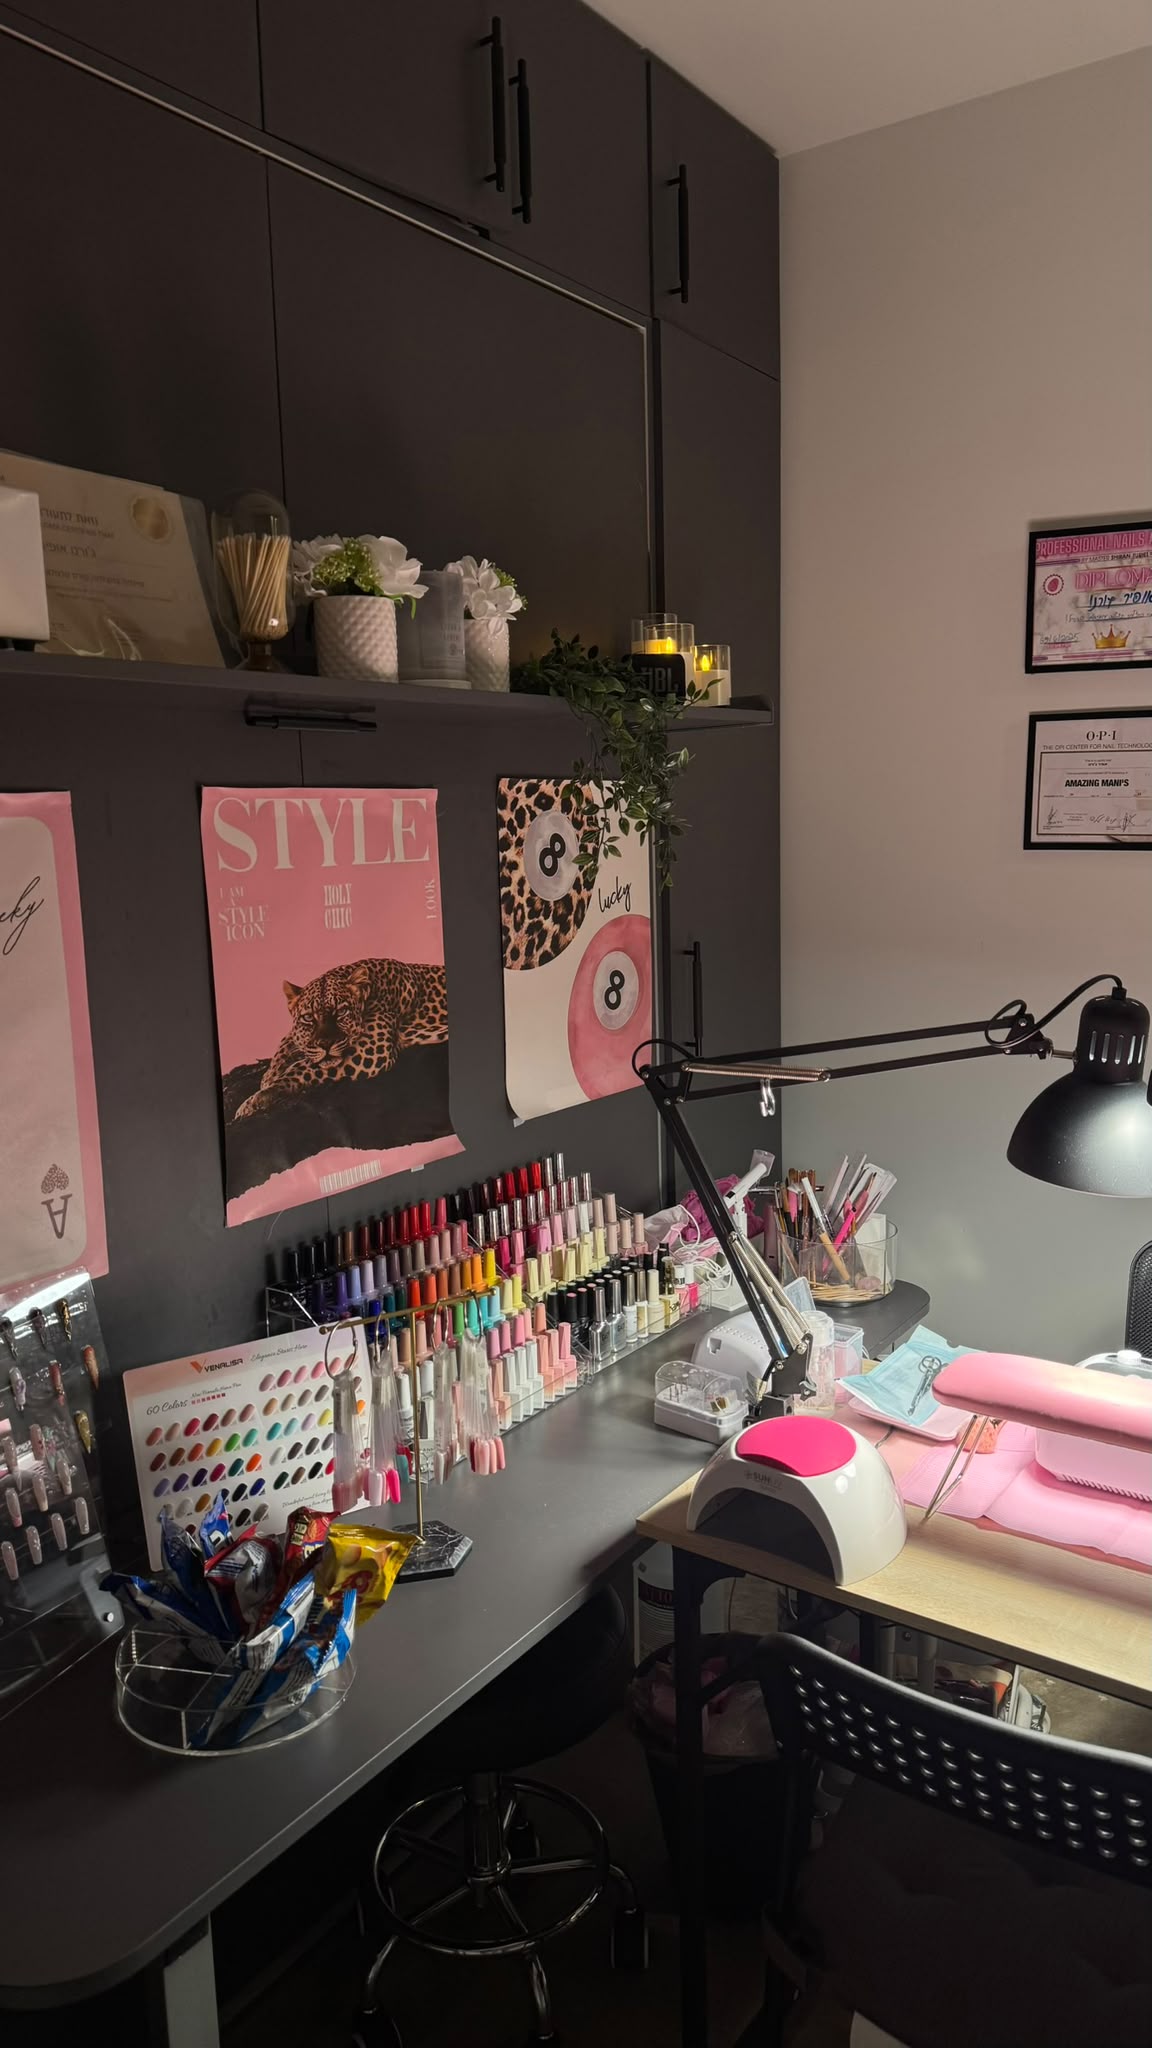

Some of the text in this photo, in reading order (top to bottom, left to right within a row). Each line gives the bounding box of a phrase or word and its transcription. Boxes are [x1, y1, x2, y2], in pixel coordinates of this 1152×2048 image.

[1036, 535, 1111, 556] PROFESSIONAL
[1113, 532, 1145, 548] NAILS
[1065, 778, 1130, 788] AMAZING MANI'S
[213, 797, 430, 873] STYLE
[539, 832, 566, 877] 8
[323, 883, 353, 906] HOLY
[424, 879, 438, 920] LOOK
[598, 876, 632, 913] lucky
[217, 905, 269, 926] STYLE
[226, 922, 265, 942] ICON
[604, 969, 625, 1010] 8
[41, 1193, 73, 1239] A
[204, 1357, 244, 1373] VENALISA
[146, 1399, 188, 1416] 60 Colors
